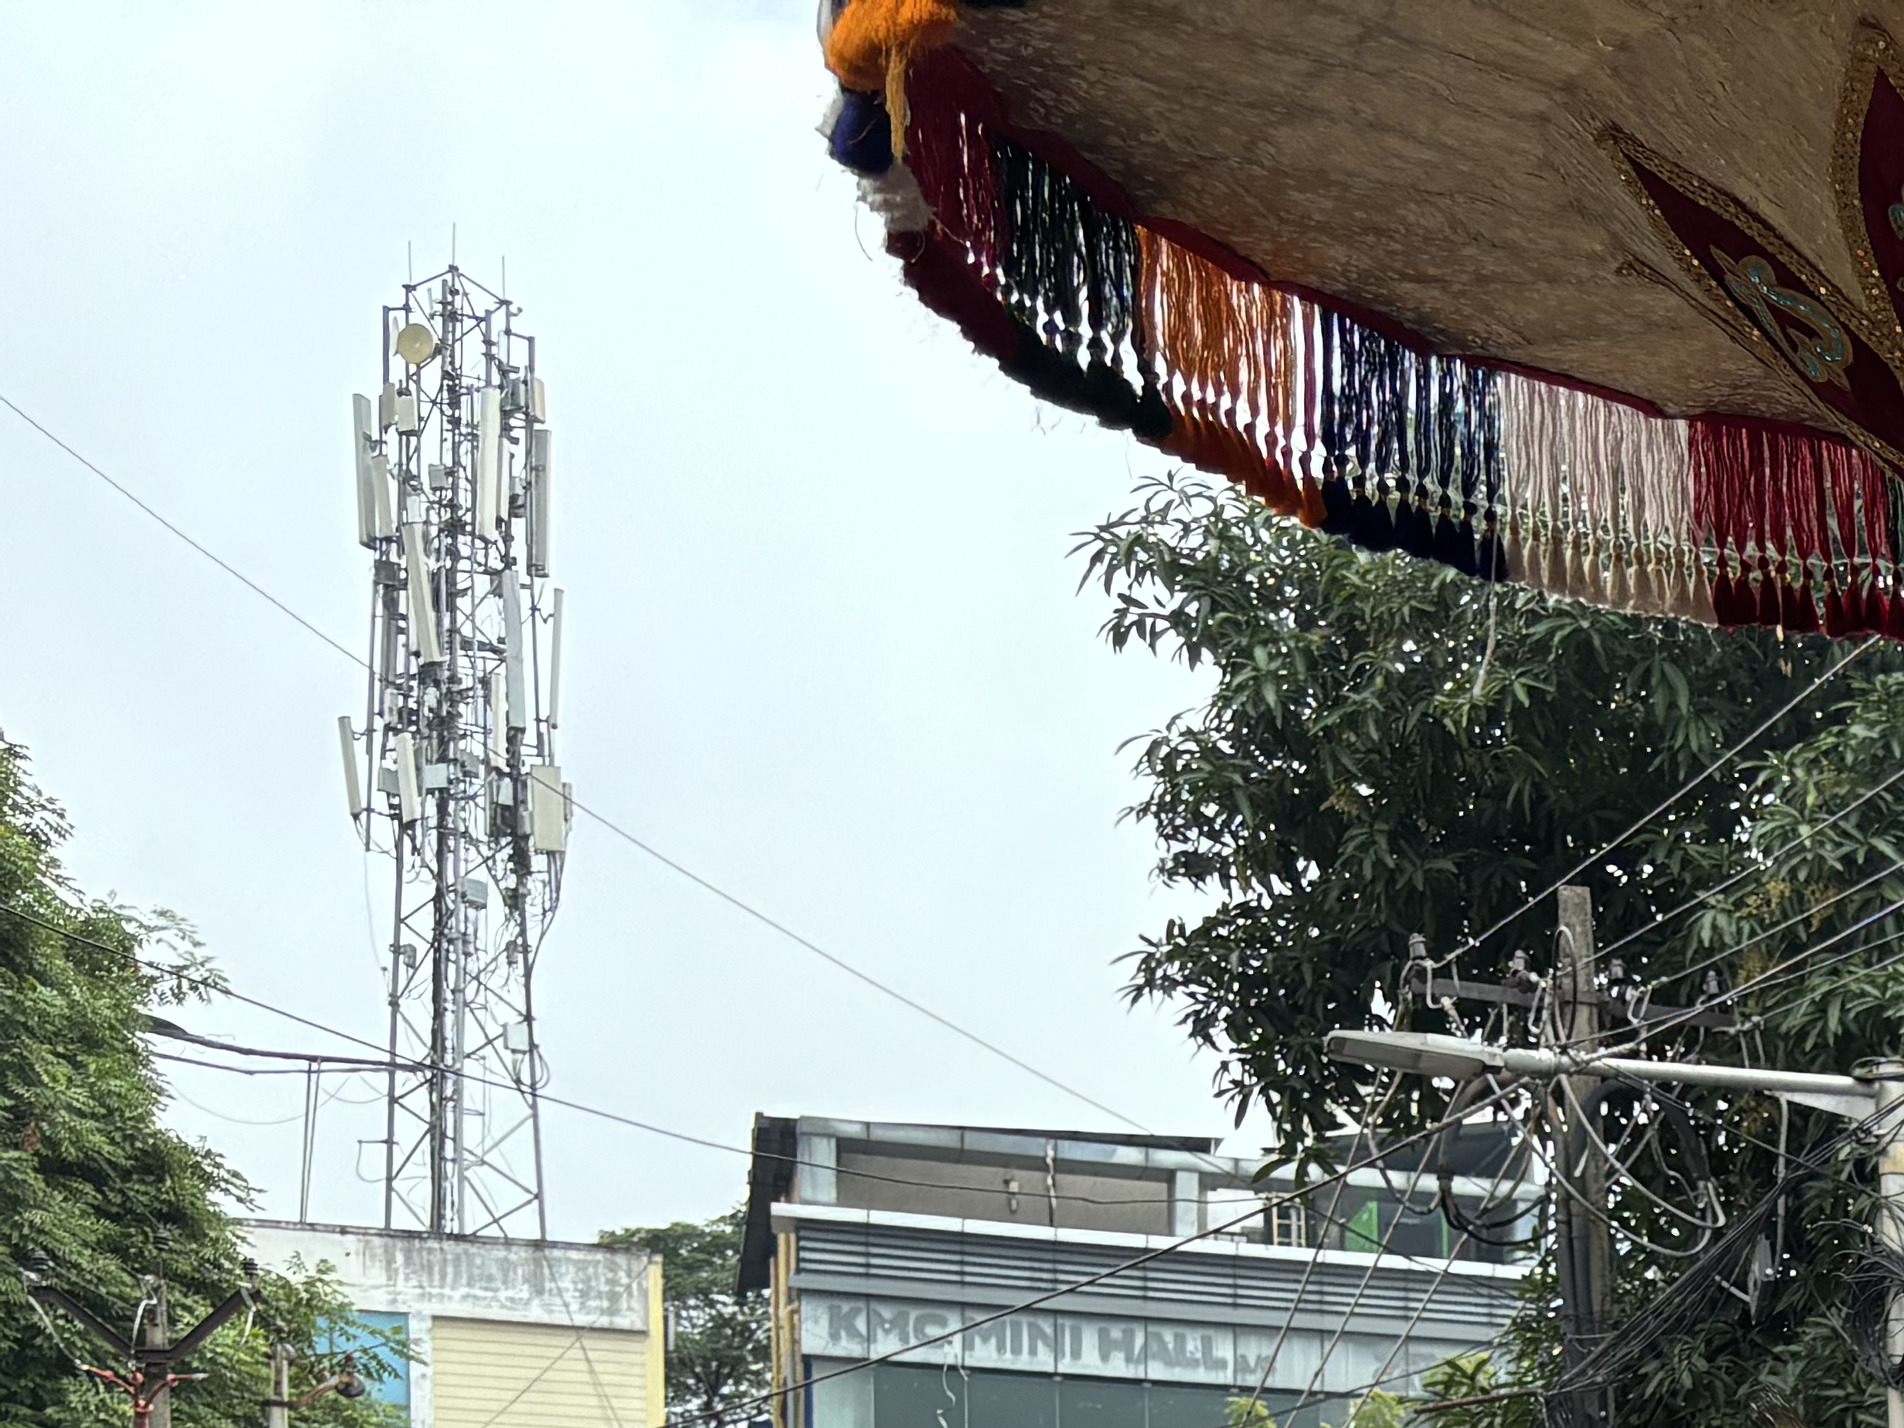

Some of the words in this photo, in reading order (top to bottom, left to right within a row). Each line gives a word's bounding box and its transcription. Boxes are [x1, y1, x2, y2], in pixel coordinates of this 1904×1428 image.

[827, 1303, 949, 1345] KMC
[966, 1316, 1084, 1362] MINI
[1100, 1326, 1228, 1371] HALL
